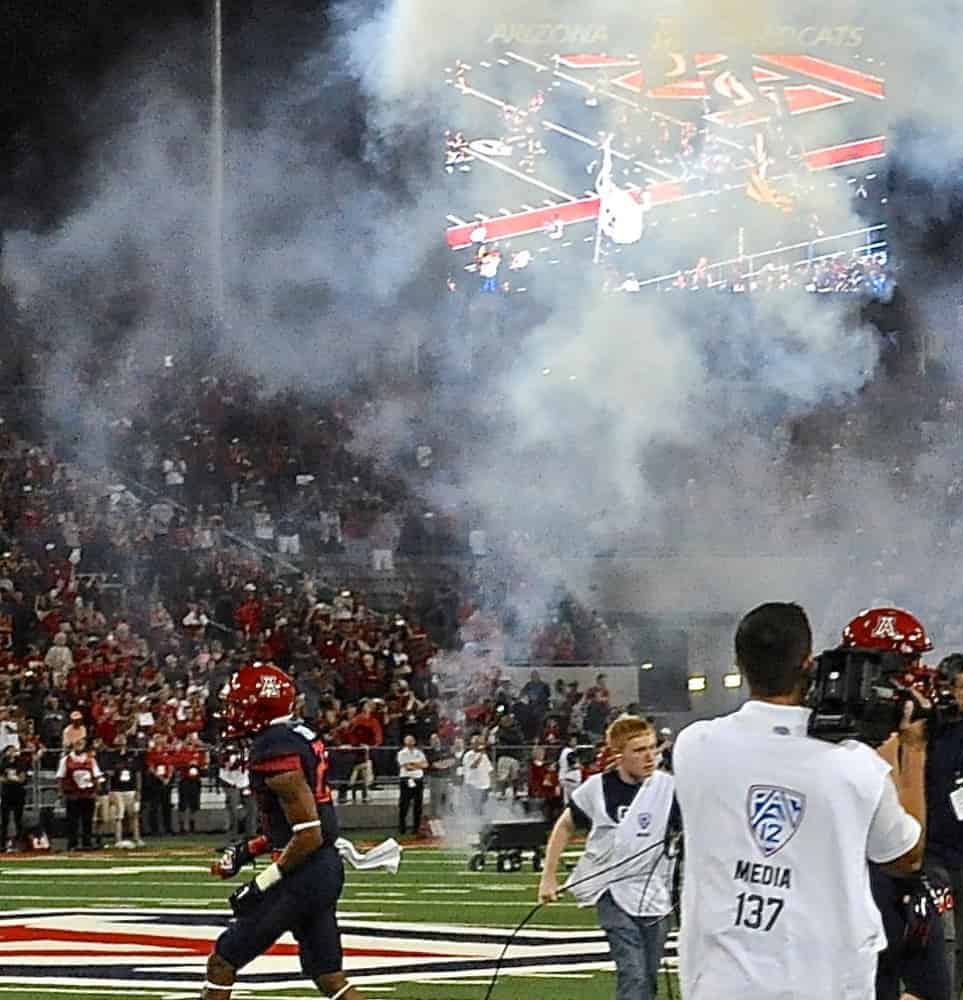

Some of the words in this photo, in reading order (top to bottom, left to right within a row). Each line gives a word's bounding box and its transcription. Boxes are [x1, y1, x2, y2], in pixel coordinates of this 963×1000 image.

[760, 823, 783, 843] 12
[734, 859, 791, 889] MEDIA
[734, 891, 784, 932] 137
